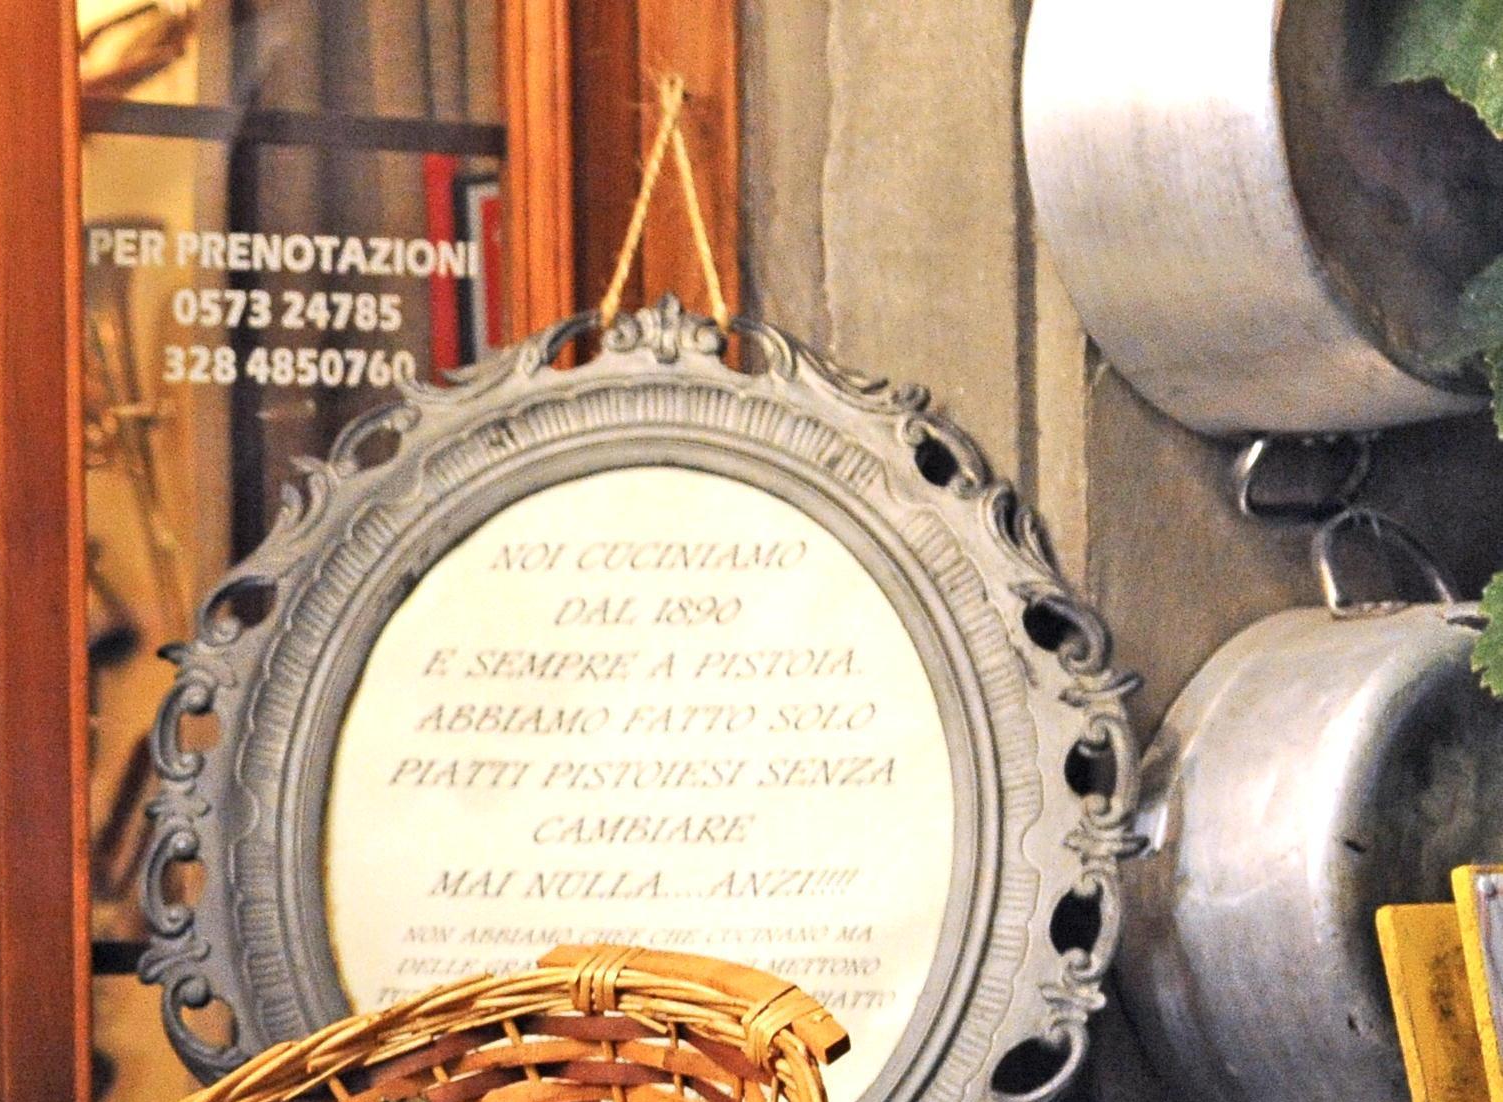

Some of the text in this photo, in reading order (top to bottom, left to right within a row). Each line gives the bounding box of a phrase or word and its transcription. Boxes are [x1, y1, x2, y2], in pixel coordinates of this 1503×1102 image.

[88, 228, 480, 278] PER PRENOTAZIONI
[172, 287, 403, 333] 0573 24785
[162, 345, 417, 388] 328 4850760
[490, 541, 806, 572] NOI CUCINIAMO
[553, 595, 743, 627] DAL 1890
[465, 648, 638, 681] SEMPRE
[649, 650, 675, 680] A
[415, 702, 877, 735] ABBIAMO FATTO SOLO
[387, 756, 897, 791] PIATTI PISTOIESI SENZA
[531, 813, 757, 845] CAMBIARE
[427, 869, 517, 901] MAI
